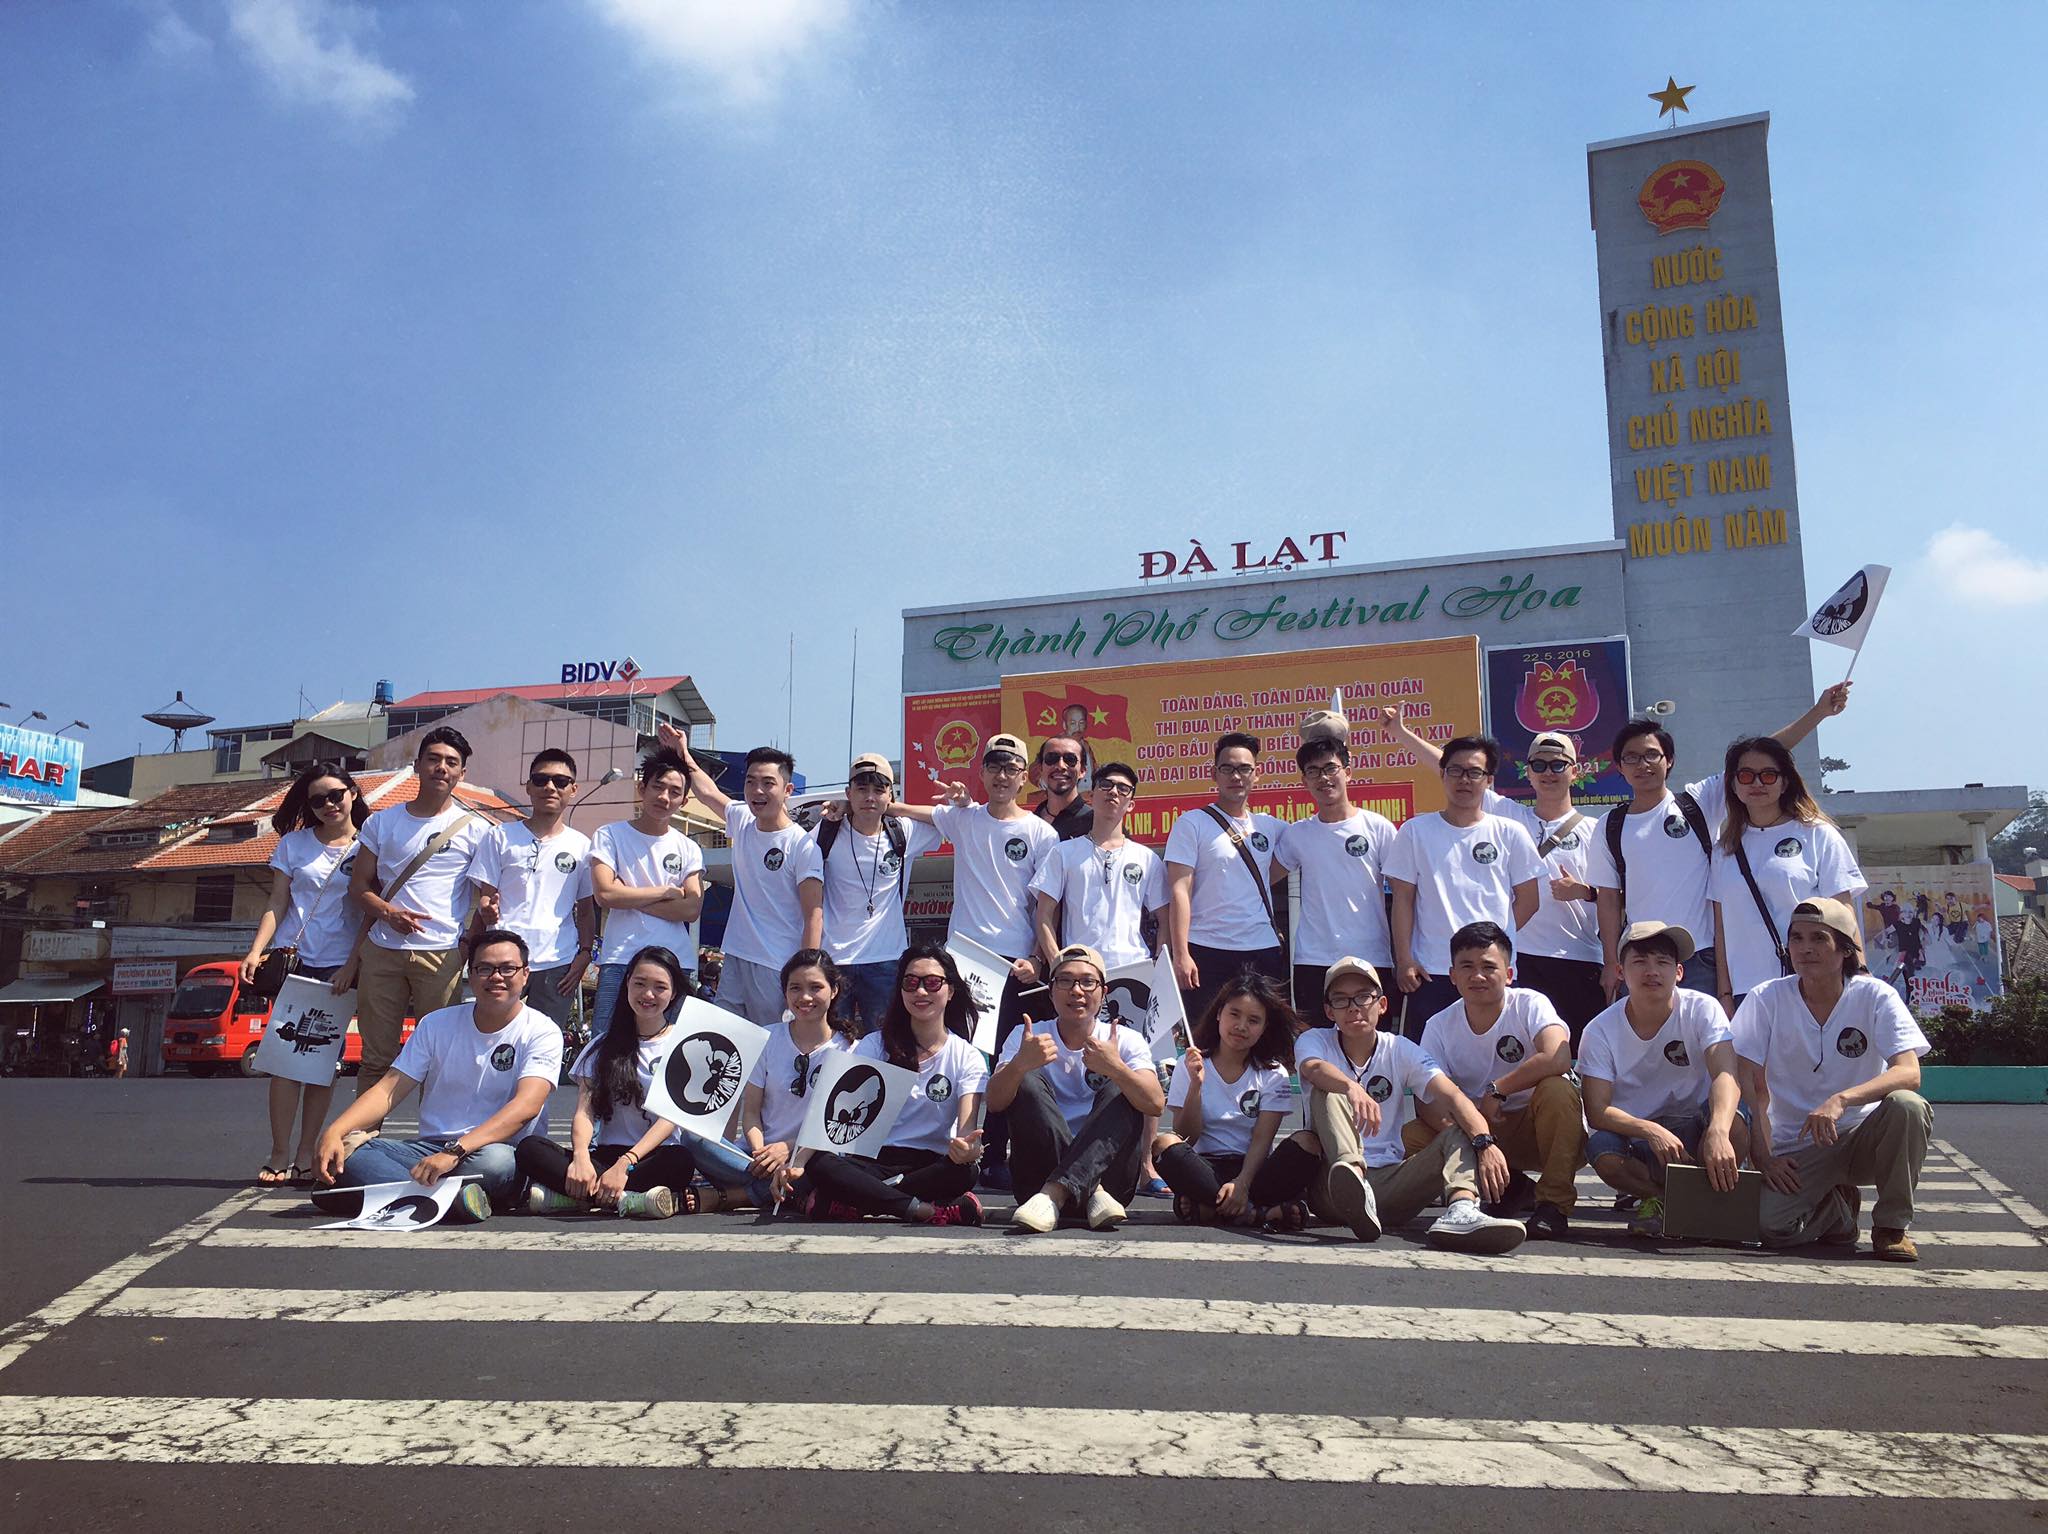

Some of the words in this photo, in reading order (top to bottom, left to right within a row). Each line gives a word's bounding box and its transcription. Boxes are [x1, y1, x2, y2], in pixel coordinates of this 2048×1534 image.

[1652, 245, 1724, 289] NƯỚC
[1625, 302, 1695, 351] CỘNG
[1706, 290, 1759, 335] HÒA
[1651, 355, 1685, 394] XÃ
[1696, 349, 1740, 393] HỘI
[1628, 402, 1679, 450] CHỦ
[1690, 396, 1772, 443] NGHĨA
[1635, 461, 1694, 507] VIỆT
[1708, 453, 1770, 496] NAM
[1629, 512, 1712, 559] MUÔN
[1725, 504, 1788, 550] NĂM
[1138, 538, 1218, 579] ĐÀ
[1231, 531, 1347, 572] LẠT
[934, 617, 1087, 665] Thành
[1093, 607, 1210, 657] Phố
[1214, 584, 1431, 641] Festival
[1441, 573, 1584, 621] Hoa
[561, 661, 617, 683] BIDV
[1522, 649, 1592, 663] 22.5.2016
[1161, 694, 1199, 713] TOÀN
[1202, 691, 1247, 710] ĐẢNG,
[1251, 687, 1291, 707] TOÀN
[1295, 684, 1331, 703] DÂN,
[1380, 677, 1424, 697] QUÂN
[1137, 743, 1175, 762] CUỘC
[1351, 727, 1376, 748] HỘI
[1427, 724, 1454, 740] XIV
[1155, 721, 1178, 737] THI
[1181, 719, 1210, 735] ĐUA
[1214, 714, 1242, 735] LẬP
[1246, 711, 1296, 730] THÀNH
[1137, 765, 1156, 783] VÀ
[1160, 766, 1184, 785] ĐẠI
[1386, 751, 1417, 767] CÁC
